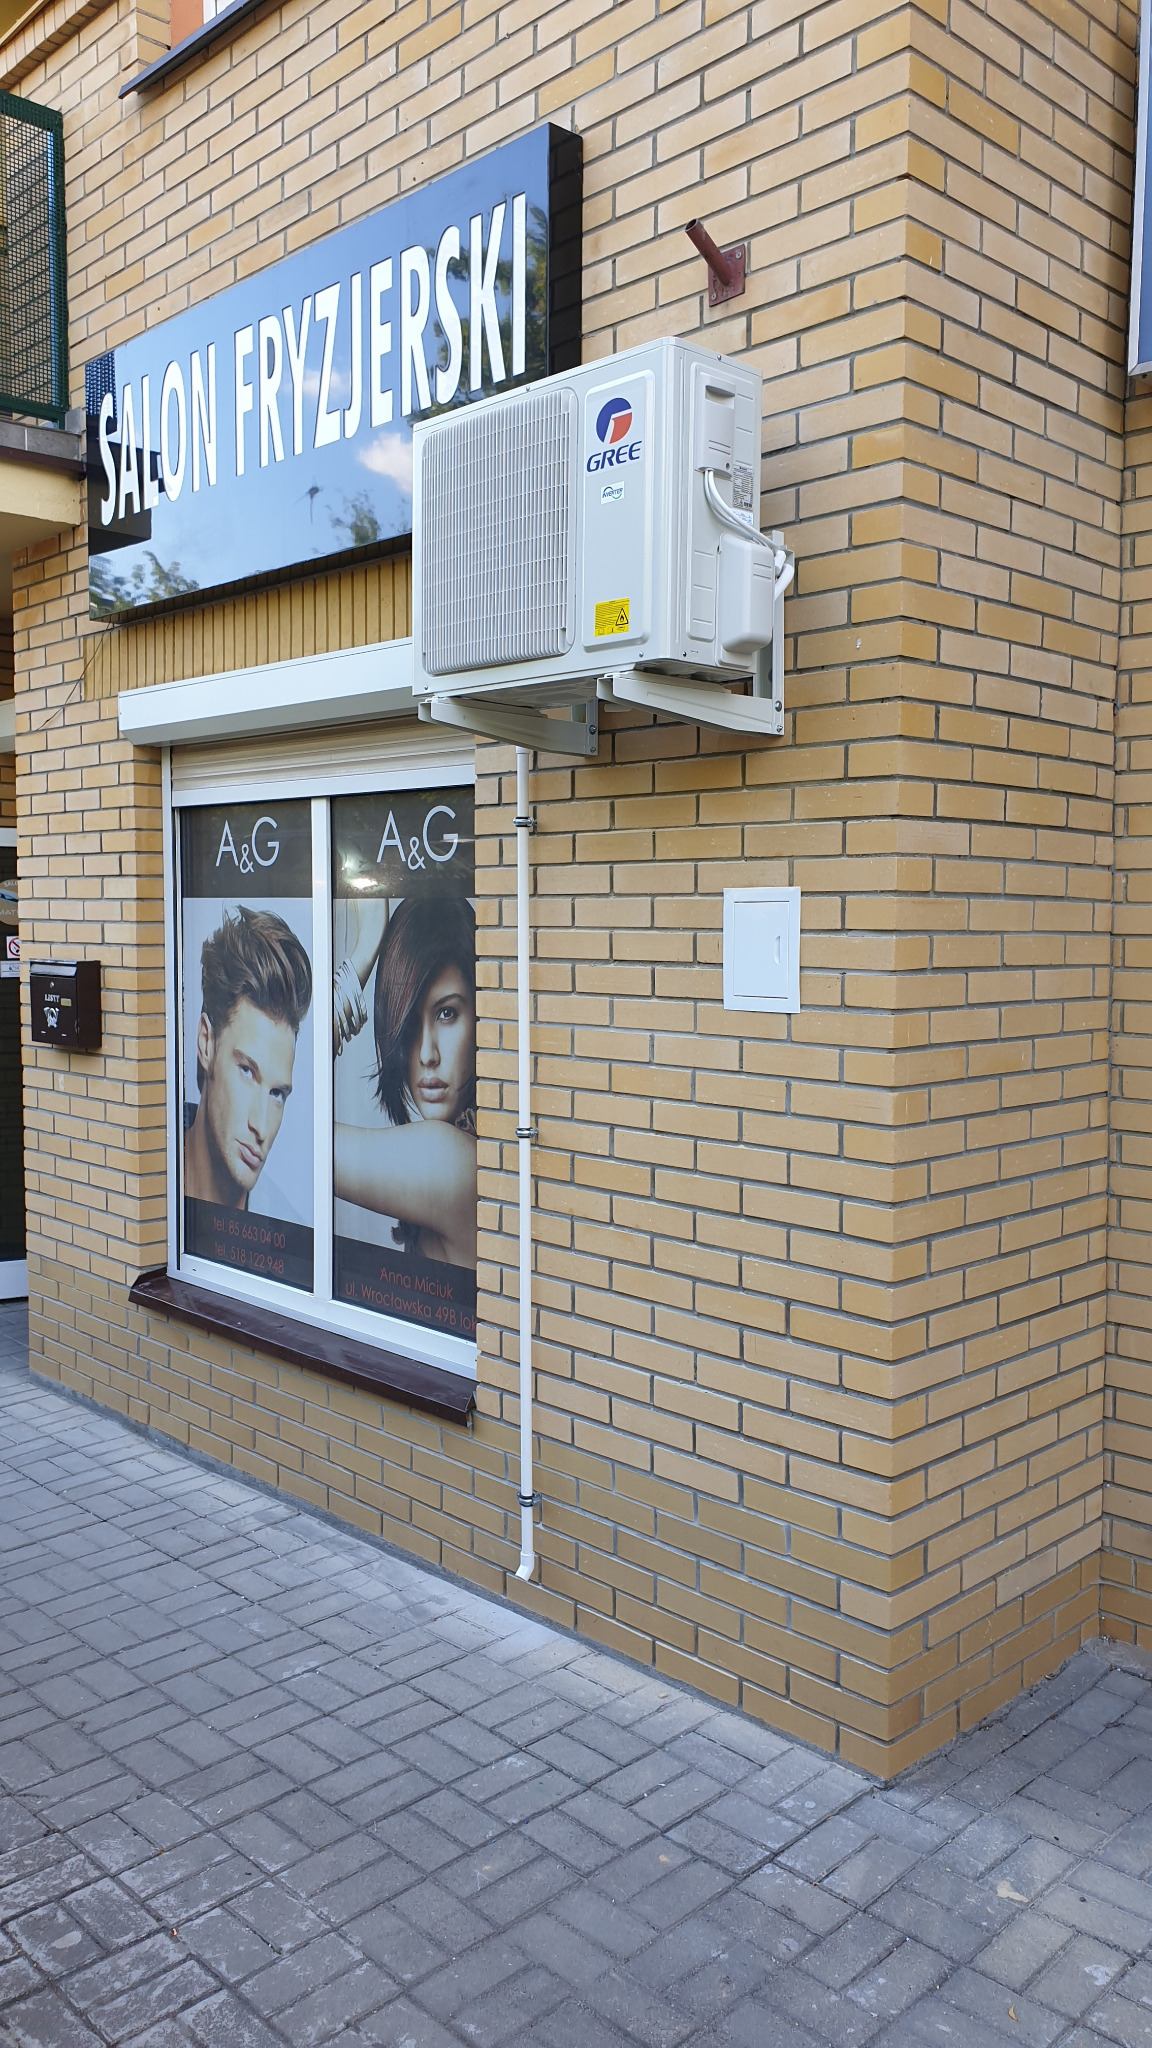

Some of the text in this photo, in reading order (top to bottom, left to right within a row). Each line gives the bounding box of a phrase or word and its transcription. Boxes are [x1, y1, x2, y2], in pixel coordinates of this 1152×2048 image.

[98, 192, 527, 527] SALON FRYZJERSKI
[586, 440, 642, 473] GREE
[215, 816, 280, 874] A&G
[376, 805, 459, 870] A&G
[44, 993, 60, 1003] LISTY
[213, 1217, 286, 1249] tel. 85 663 04 00
[214, 1241, 284, 1275] tel. 518 122 948
[380, 1266, 454, 1300] Anna Miciuk
[345, 1281, 358, 1297] ul.
[361, 1284, 432, 1319] Wrocławska
[435, 1305, 457, 1326] 49B
